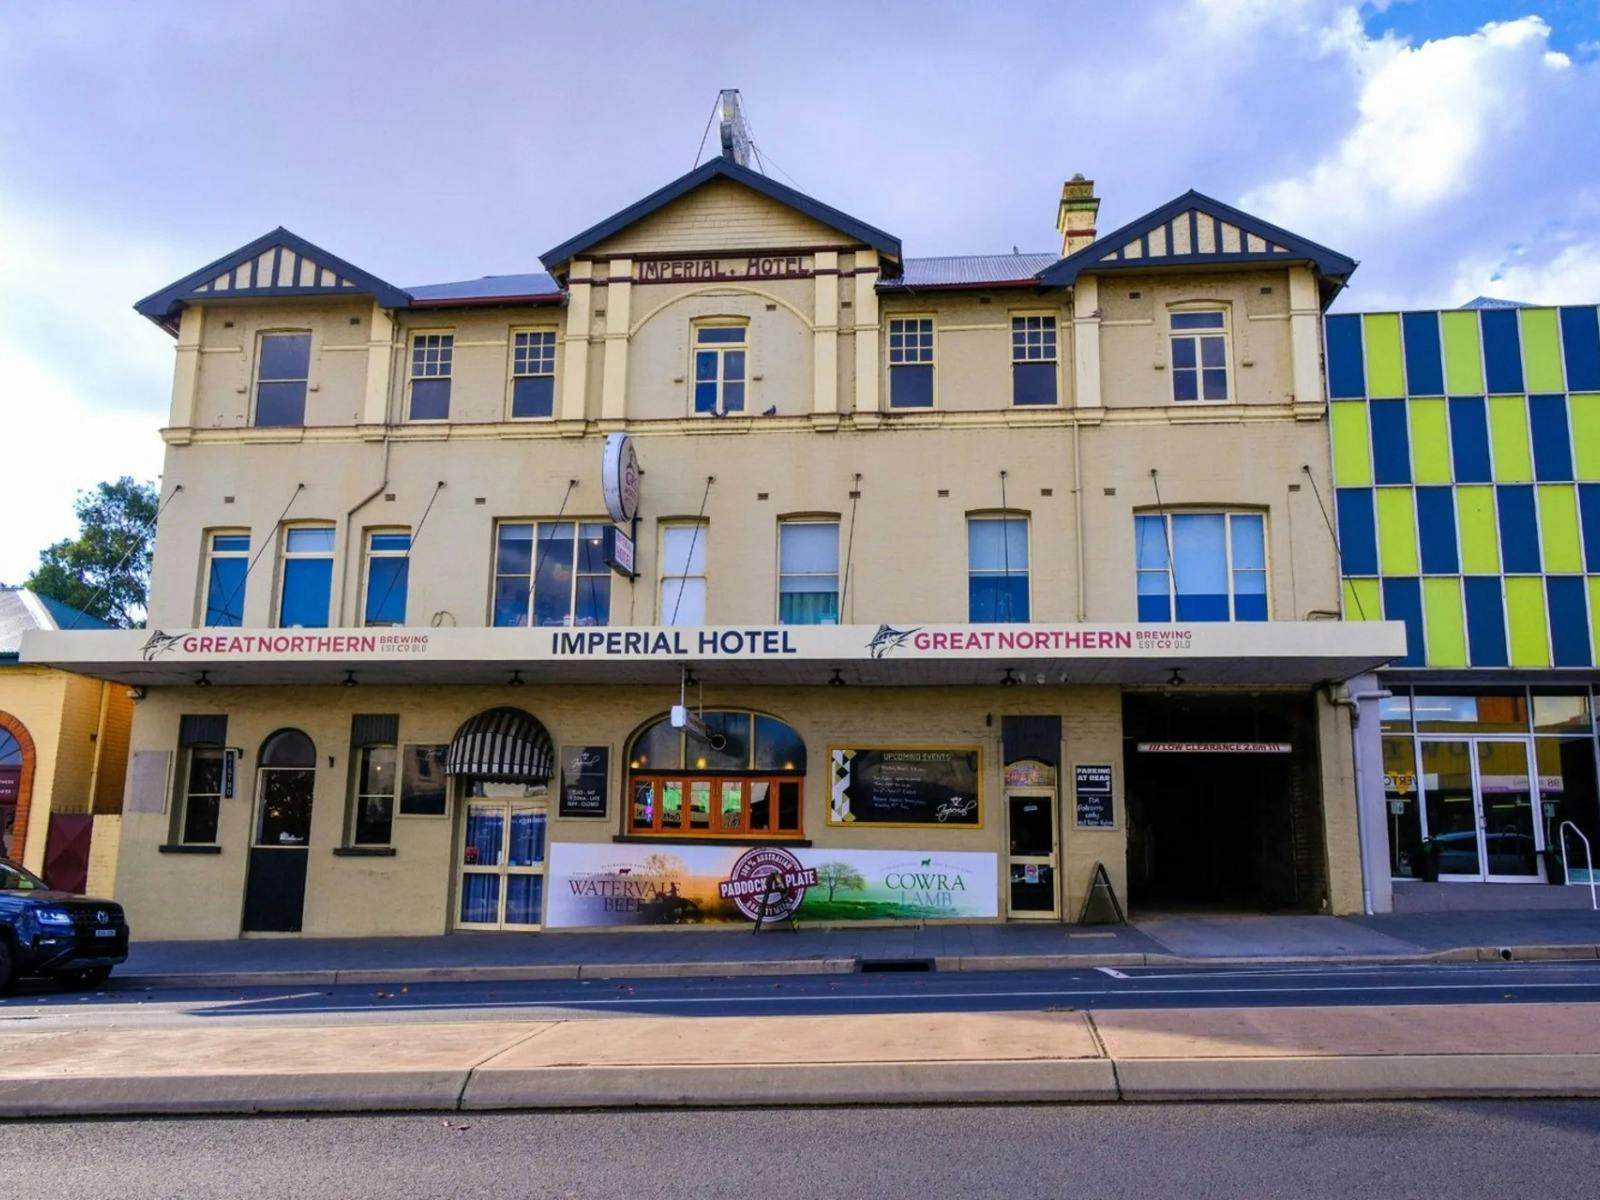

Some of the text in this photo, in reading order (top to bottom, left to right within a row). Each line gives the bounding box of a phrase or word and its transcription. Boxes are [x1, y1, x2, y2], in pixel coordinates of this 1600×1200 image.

[638, 260, 726, 280] IMPERIAL
[183, 635, 376, 653] GREAT NORTHERN
[380, 635, 428, 644] BREWING
[551, 630, 797, 655] IMPERIAL HOTEL
[913, 630, 1132, 650] GREAT NORTHERN
[1136, 631, 1192, 639] BREWING
[1185, 743, 1242, 751] CLEARANCE
[720, 877, 768, 898] PADDOCK
[785, 870, 816, 888] PLATE
[885, 872, 966, 891] COWRA
[900, 891, 953, 907] LAMB
